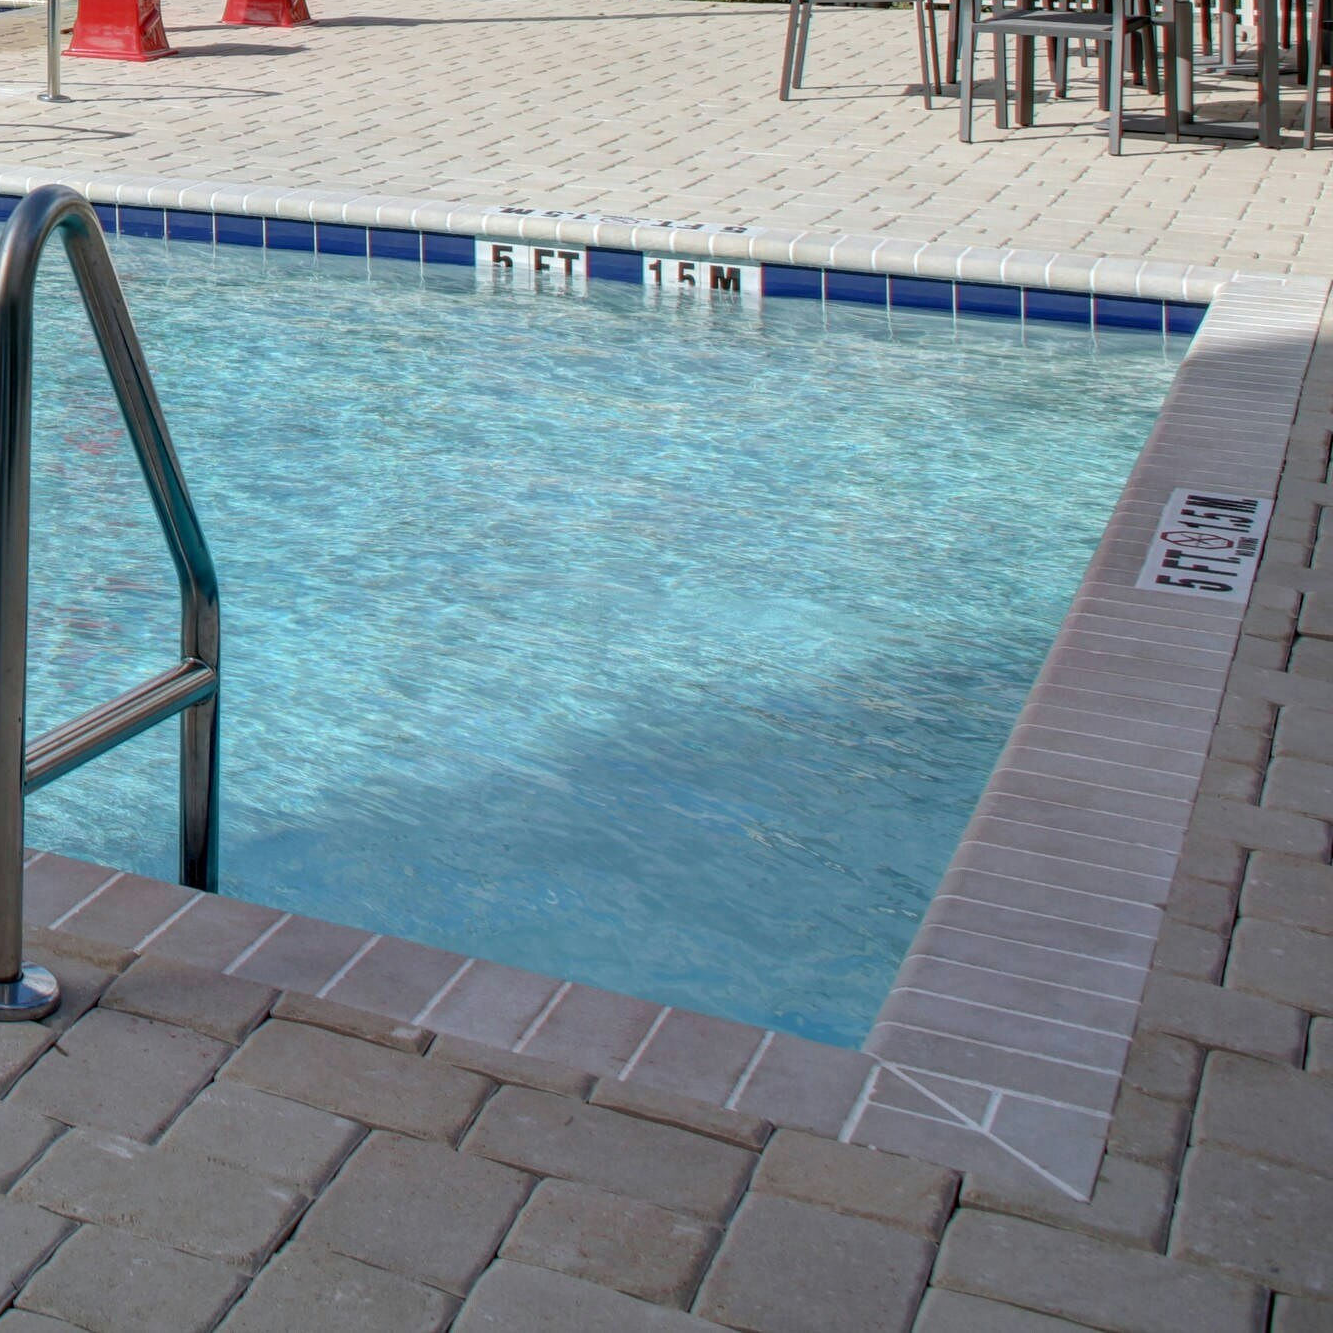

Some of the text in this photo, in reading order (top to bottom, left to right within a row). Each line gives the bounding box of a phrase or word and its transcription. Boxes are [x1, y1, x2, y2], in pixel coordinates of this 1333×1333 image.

[492, 244, 514, 268] 5
[534, 248, 580, 276] FT
[1177, 509, 1254, 533] 1.5
[1162, 549, 1241, 576] FT.
[1156, 575, 1233, 592] 5
